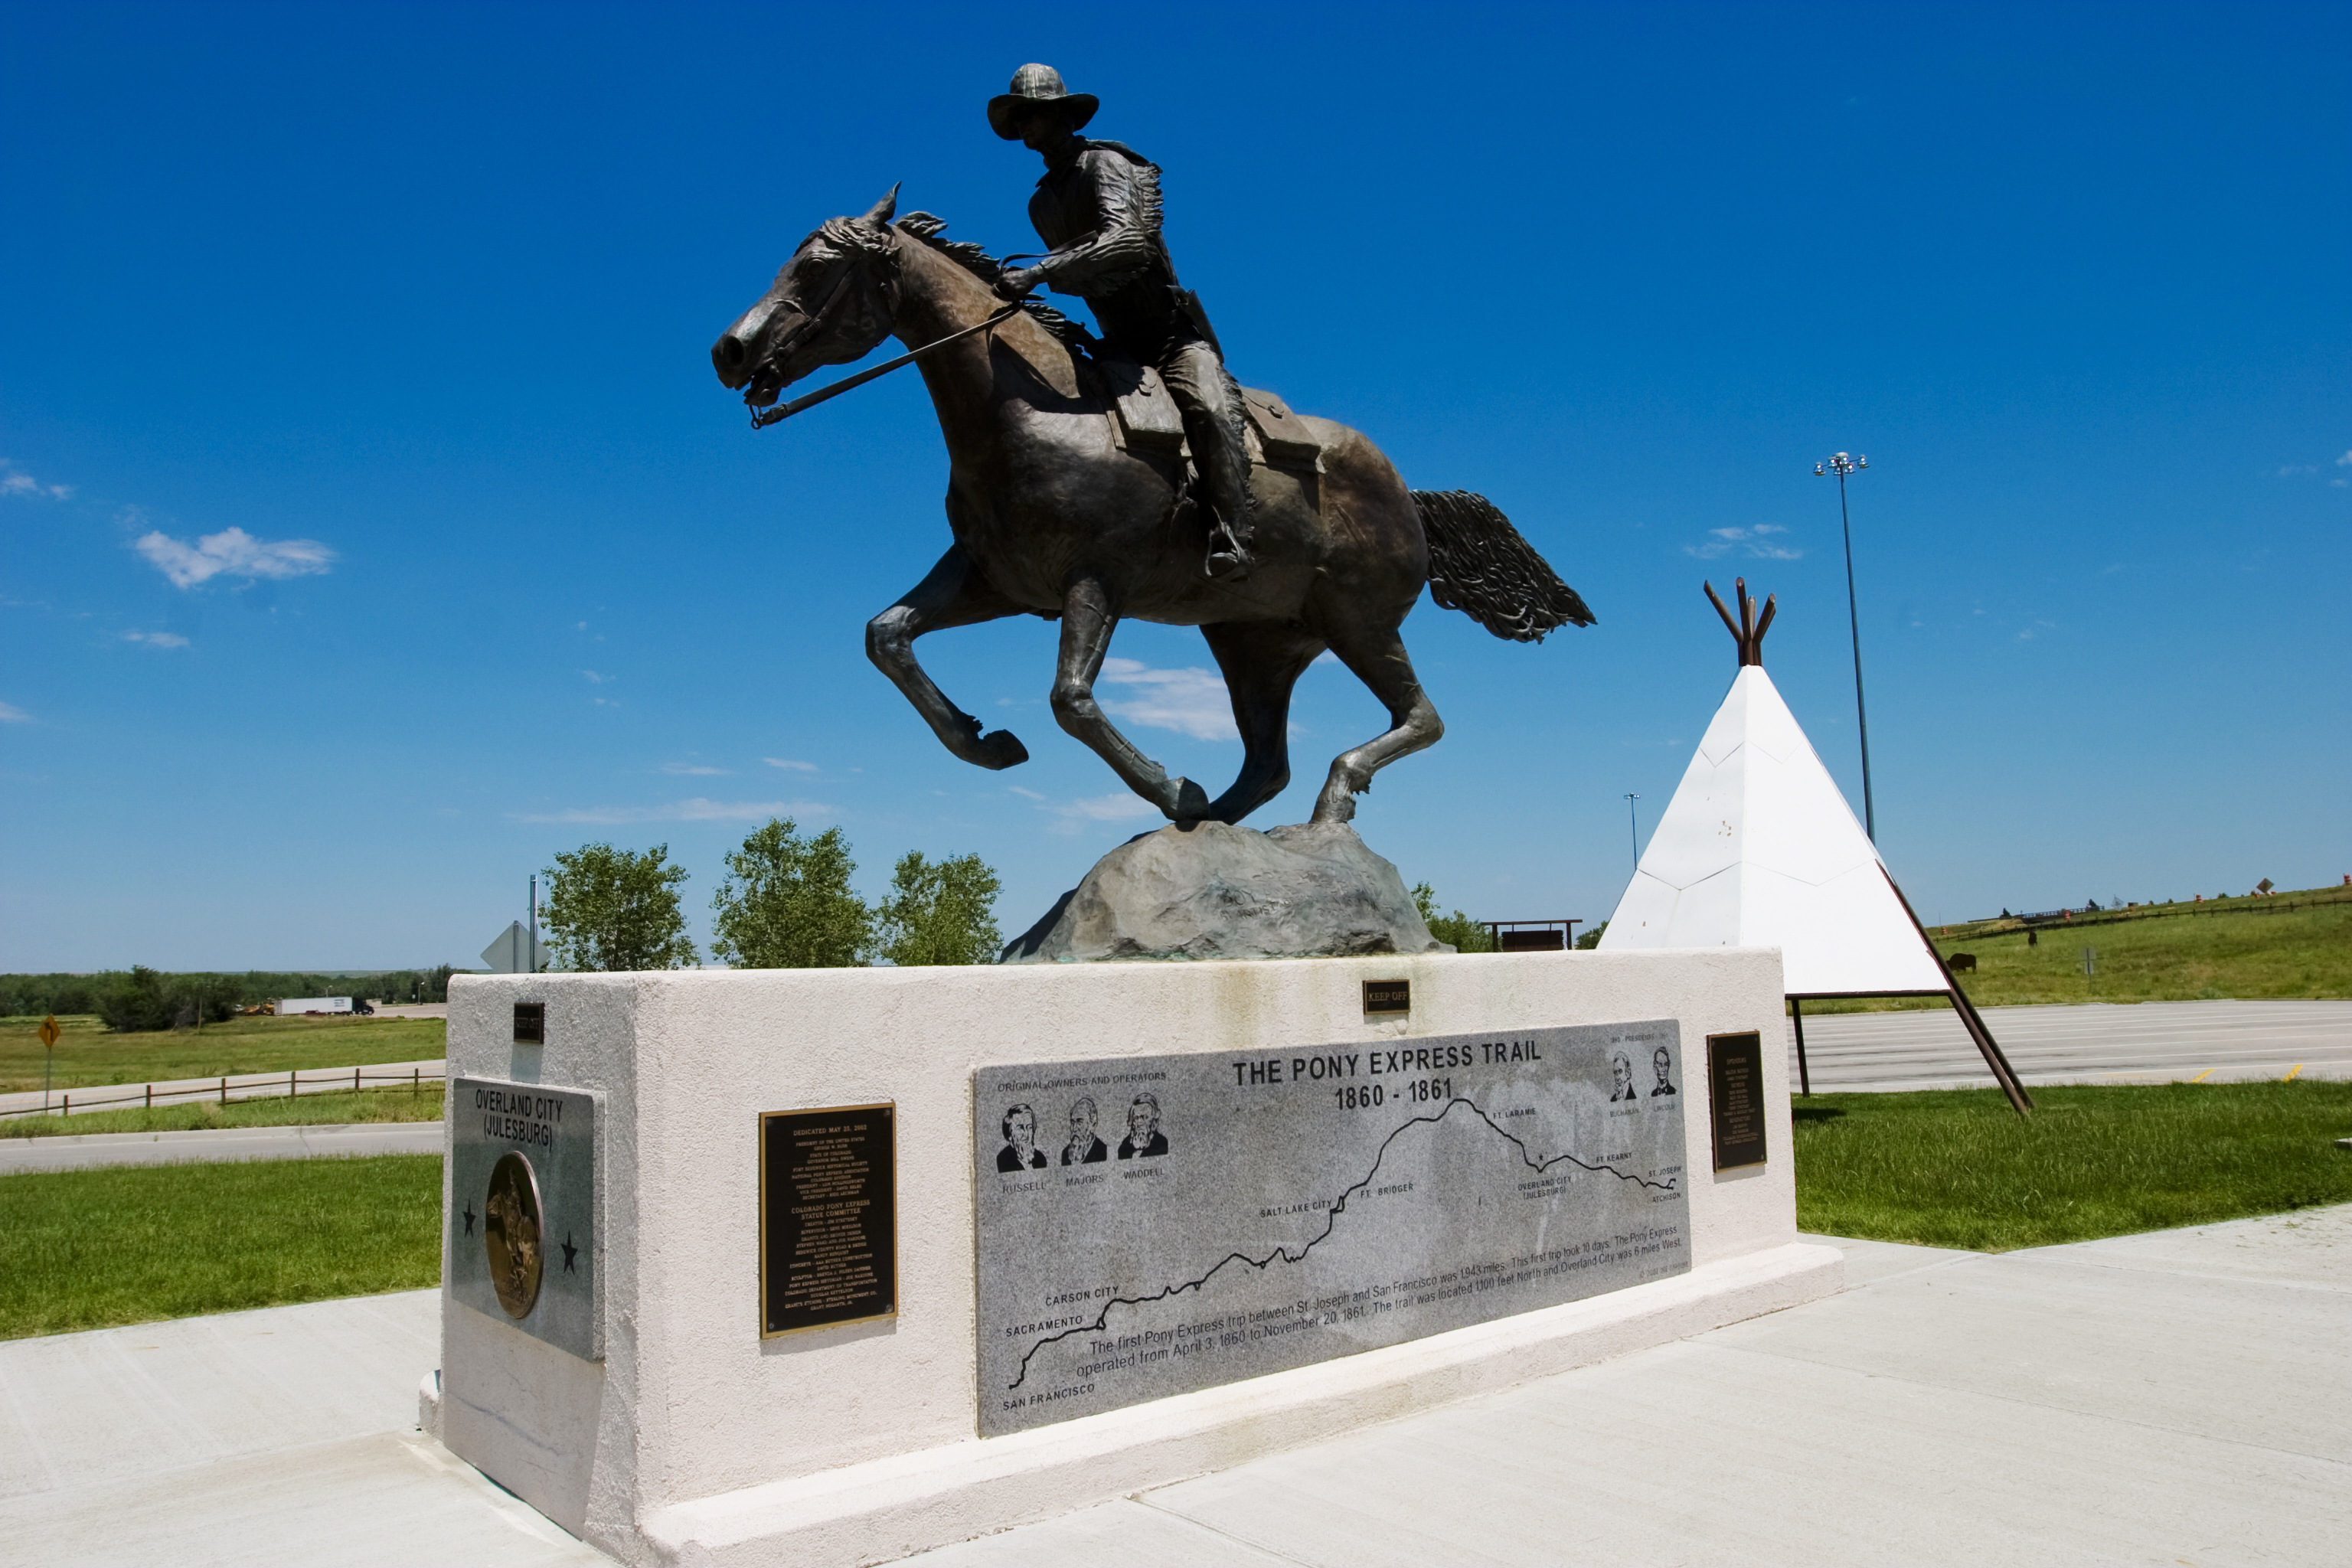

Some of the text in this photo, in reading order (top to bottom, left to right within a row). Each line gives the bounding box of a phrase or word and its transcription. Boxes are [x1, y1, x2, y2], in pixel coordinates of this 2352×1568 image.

[1368, 991, 1408, 1001] KEEP OFF
[1232, 1040, 1541, 1086] THE PONY EXPRESS TRAIL
[998, 1072, 1166, 1092] ORIGINAL OWNERS AND OPERATORS
[1334, 1084, 1383, 1110] 1860
[1408, 1077, 1452, 1102] 1861
[475, 1088, 563, 1122] OVERLAND CITY
[1654, 1102, 1675, 1112] LINCOLN
[1505, 1107, 1537, 1118] LARAMIE
[1609, 1107, 1639, 1118] BUCHANAN
[484, 1114, 553, 1153] (JULESBURG)
[793, 1127, 827, 1136] DEDICATED
[1607, 1152, 1632, 1162] KEARNY
[1123, 1168, 1165, 1180] WADDELL
[1658, 1165, 1682, 1176] JOSEPH
[1002, 1181, 1046, 1194] RUSSELL
[1066, 1174, 1104, 1187] MAJORS
[1517, 1175, 1572, 1191] OVERLAND CITY
[1377, 1183, 1413, 1197] BRIDGER
[1523, 1186, 1566, 1200] (JULESBURG)
[1652, 1192, 1681, 1204] ATCHISON
[791, 1205, 825, 1214] COLORADO
[845, 1199, 871, 1208] EXPRESS
[801, 1207, 861, 1220] STATUE COMMITTEE
[1259, 1199, 1332, 1218] SALT LAKE CITY
[1045, 1285, 1119, 1307] CARSON CITY
[1089, 1341, 1113, 1355] The
[1118, 1333, 1142, 1350] first
[1145, 1329, 1174, 1345] Pony
[1178, 1318, 1225, 1338] Express
[1227, 1314, 1246, 1328] trip
[1249, 1305, 1294, 1324] between
[1314, 1292, 1350, 1310] Joseph
[1352, 1287, 1370, 1302] and
[1372, 1284, 1391, 1298] San
[1393, 1276, 1437, 1294] Francisco
[1439, 1272, 1458, 1284] was
[1483, 1262, 1508, 1275] miles.
[1511, 1256, 1529, 1269] This
[1531, 1252, 1547, 1263] first
[1548, 1250, 1562, 1262] trip
[1563, 1245, 1580, 1257] took
[1582, 1242, 1590, 1253] 10
[1615, 1235, 1629, 1246] The
[1630, 1232, 1648, 1243] Pony
[1648, 1226, 1677, 1240] Express
[1076, 1352, 1135, 1379] operated
[1139, 1348, 1168, 1365] from
[1173, 1340, 1202, 1358] April
[1205, 1336, 1215, 1350] 3,
[1220, 1329, 1246, 1348] 1860
[1250, 1328, 1261, 1341] to
[1263, 1316, 1320, 1338] November
[1323, 1310, 1339, 1325] 20,
[1372, 1302, 1392, 1315] The
[1394, 1295, 1414, 1309] trail
[1416, 1292, 1436, 1305] was
[1438, 1282, 1472, 1301] located
[1497, 1275, 1514, 1286] feet
[1517, 1267, 1541, 1282] North
[1543, 1264, 1559, 1277] and
[1560, 1255, 1597, 1272] Overland
[1599, 1253, 1615, 1265] City
[1616, 1249, 1632, 1262] was
[1634, 1246, 1640, 1256] 6
[1641, 1243, 1661, 1255] miles
[1006, 1315, 1083, 1338] SACRAMENTO
[1003, 1383, 1095, 1411] SAN FRANCISCO
